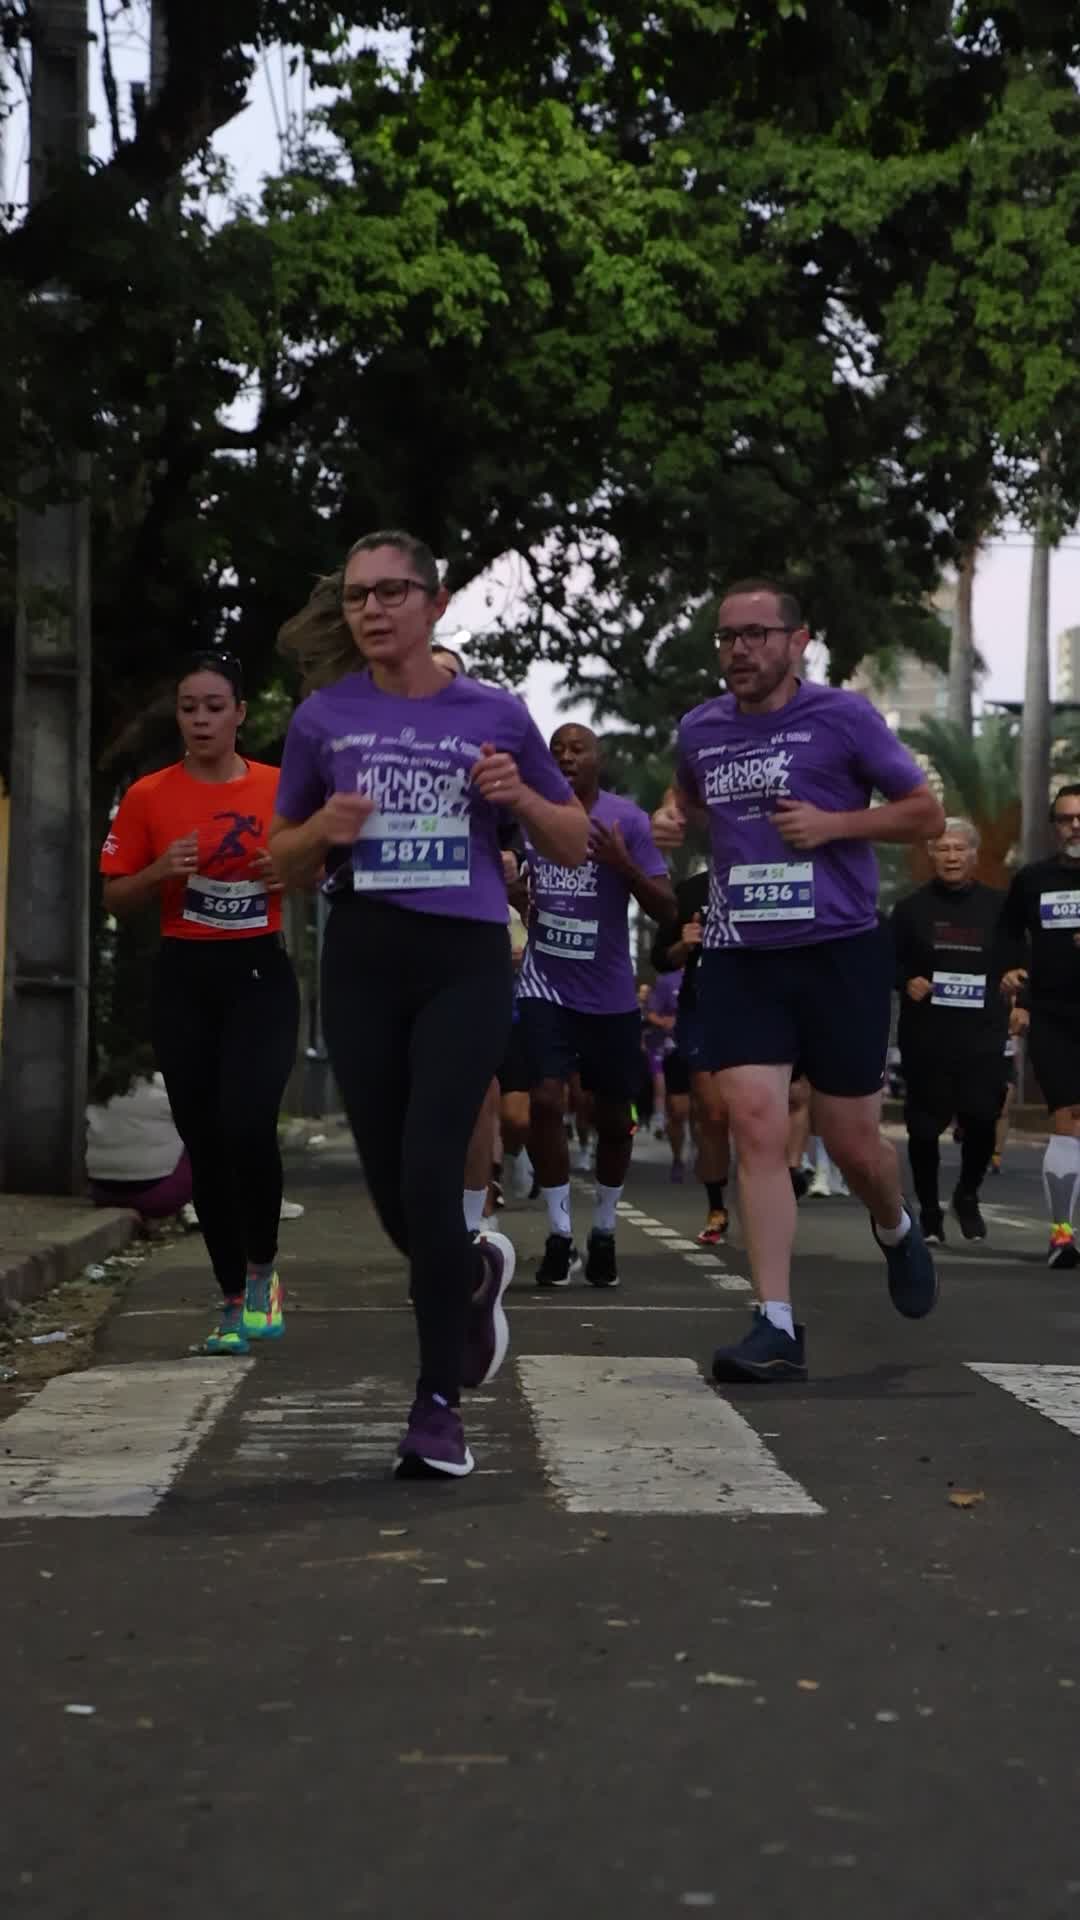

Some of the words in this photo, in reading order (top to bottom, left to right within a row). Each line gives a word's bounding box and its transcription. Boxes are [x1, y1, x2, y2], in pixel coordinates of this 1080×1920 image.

[705, 756, 779, 781] MUNDO
[357, 765, 450, 794] MUNDO
[705, 771, 785, 796] MELHOR
[381, 840, 444, 863] 5871
[743, 885, 793, 903] 5436
[203, 897, 252, 914] 5697
[546, 929, 582, 945] 6118
[944, 985, 974, 996] 6271
